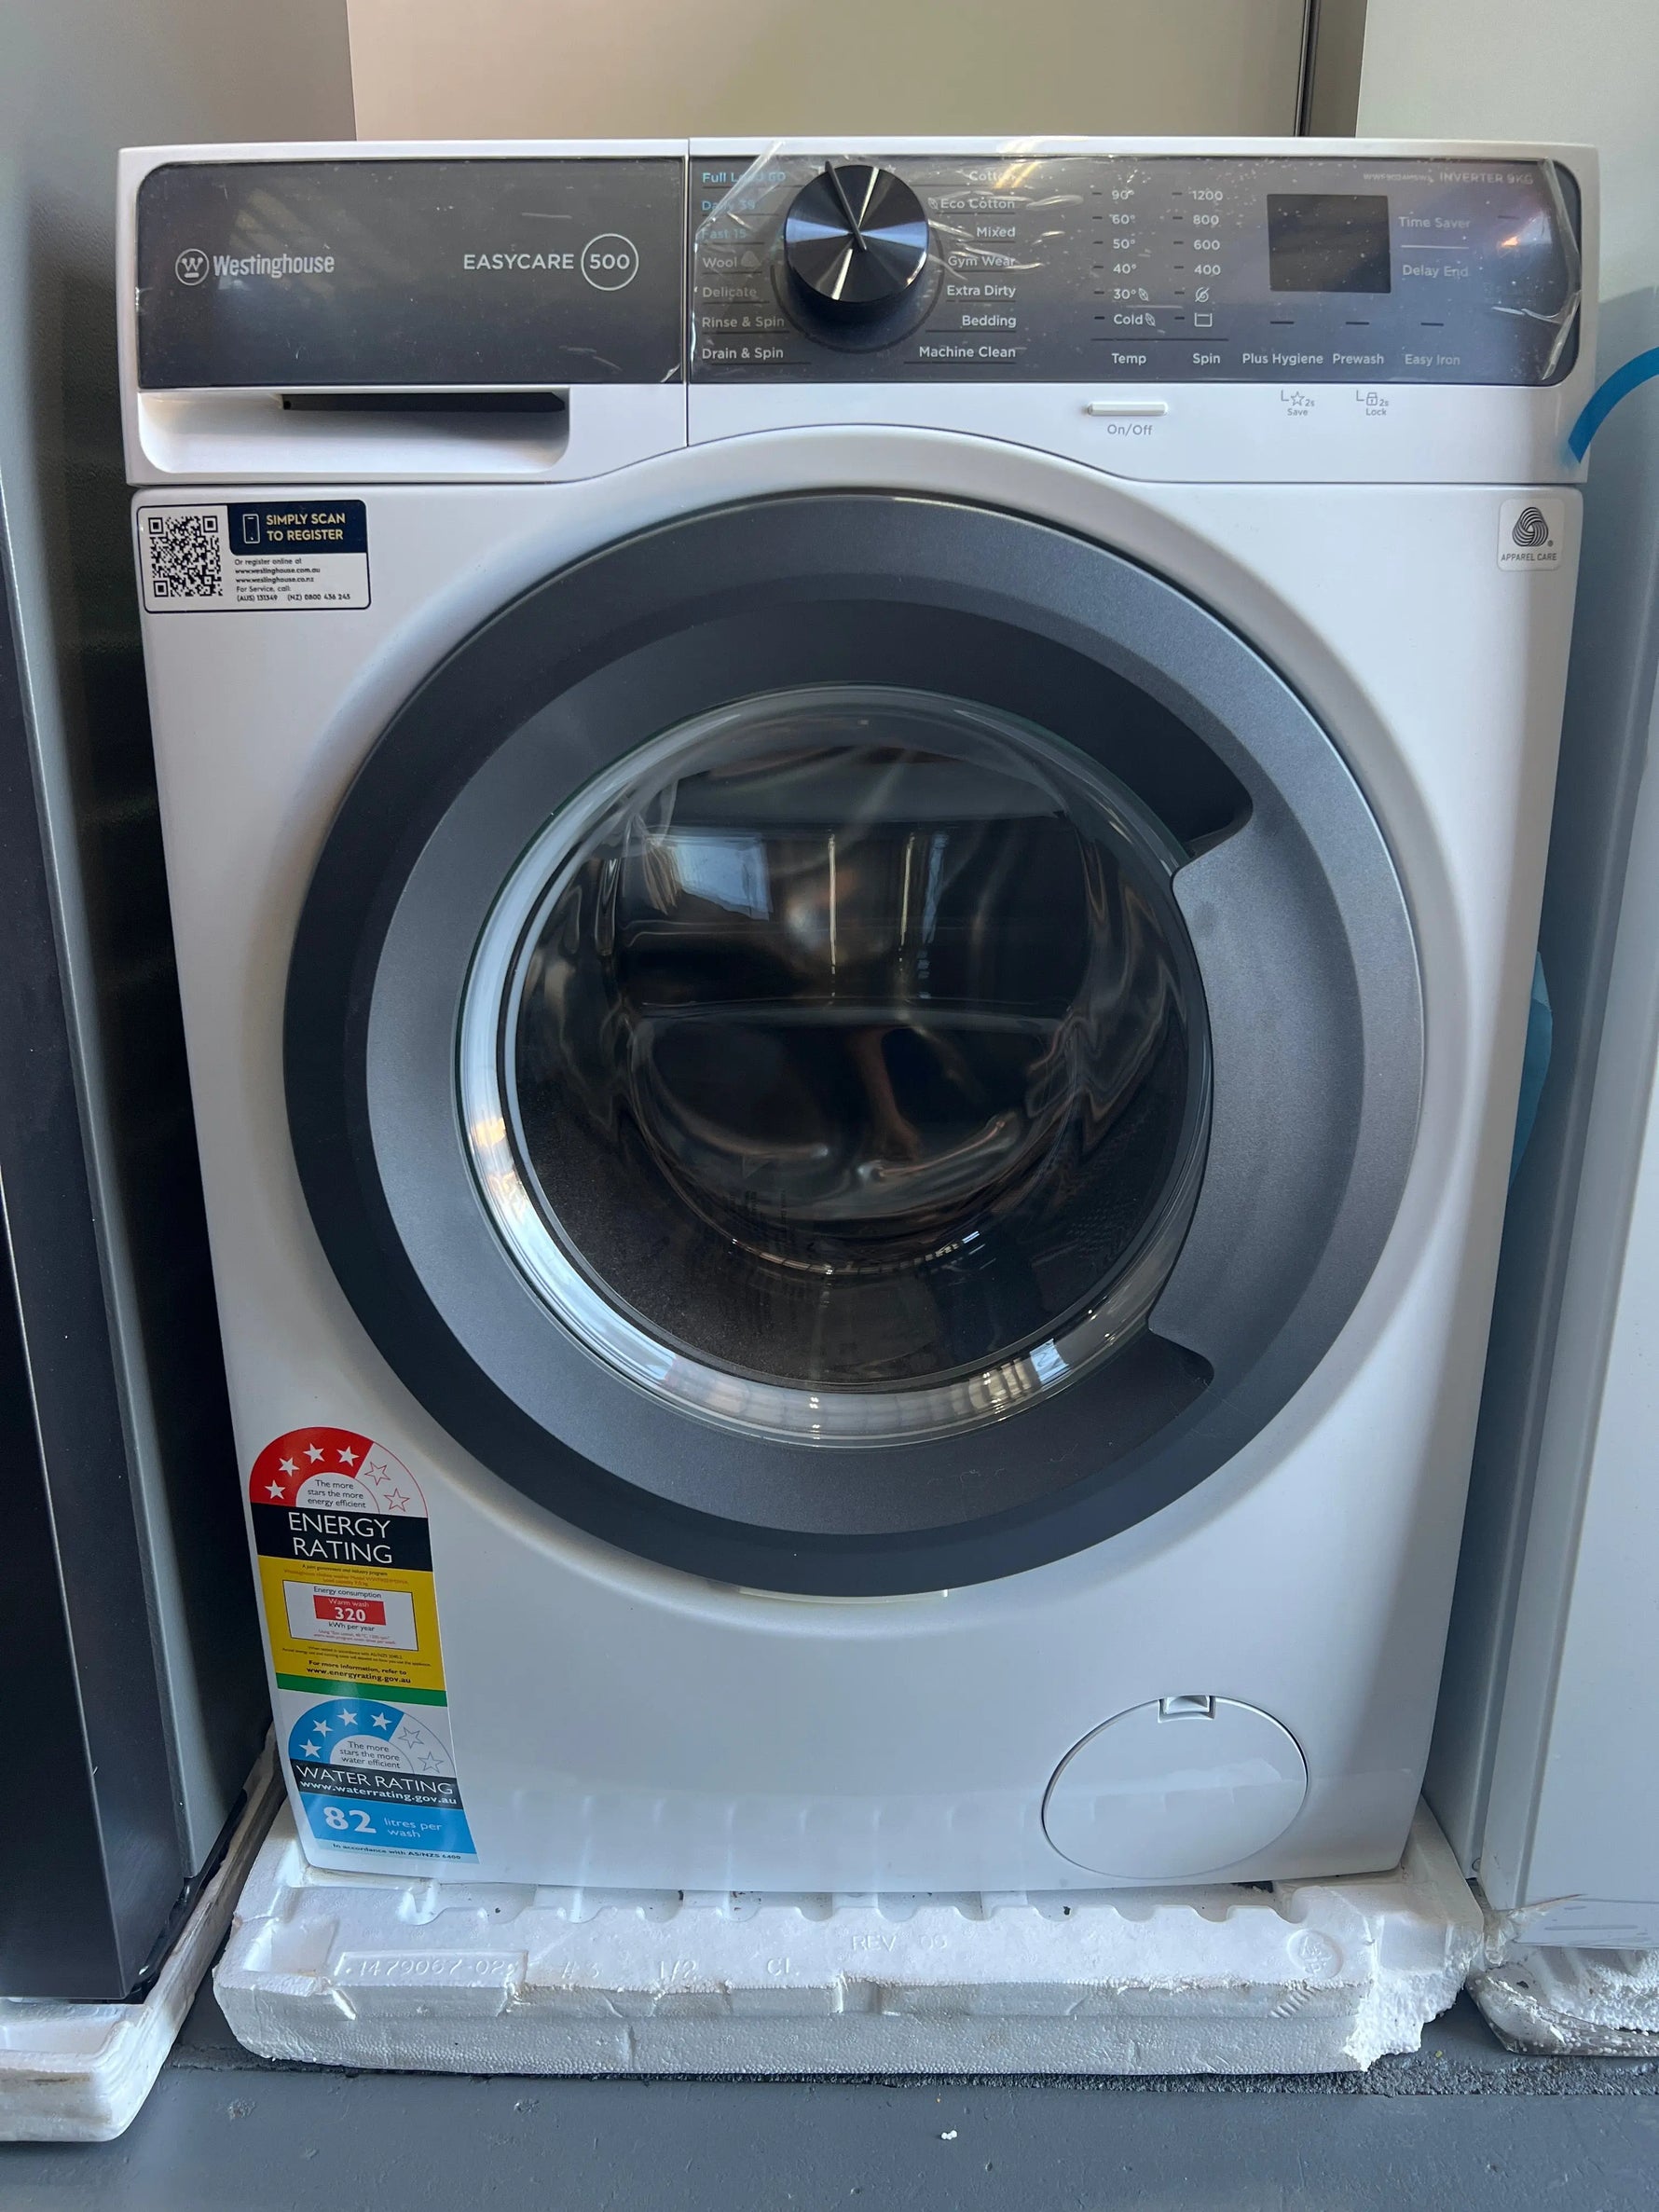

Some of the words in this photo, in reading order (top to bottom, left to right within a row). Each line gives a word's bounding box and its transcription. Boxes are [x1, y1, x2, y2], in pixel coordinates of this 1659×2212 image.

[702, 172, 726, 184] Full
[1439, 172, 1503, 184] INVERTER
[1506, 173, 1534, 185] 9KG
[1192, 190, 1223, 200] 1200
[940, 199, 966, 210] Eco
[968, 198, 1015, 210] Cotton
[1112, 214, 1136, 225] 60°
[1193, 215, 1220, 226] 800
[1398, 216, 1431, 229] Time
[1433, 217, 1471, 229] Saver
[701, 228, 730, 240] Fast
[733, 229, 747, 240] 15
[976, 227, 1016, 238] Mixed
[1113, 240, 1136, 250] 50°
[1193, 240, 1221, 251] 600
[213, 254, 335, 278] Westinghouse
[463, 254, 574, 270] EASYCARE
[589, 254, 631, 270] 500
[703, 257, 737, 269] Wool
[948, 255, 978, 268] Gym
[981, 255, 1017, 267] Wear
[1113, 264, 1137, 274] 40°
[1194, 265, 1221, 275] 400
[1402, 265, 1439, 279] Delay
[1444, 266, 1469, 278] End
[702, 286, 758, 298] Delicate
[947, 285, 980, 296] Extra
[982, 285, 1017, 299] Dirty
[1113, 289, 1137, 300] 30°
[702, 316, 741, 328] Rinse
[742, 317, 752, 328] &
[754, 316, 786, 331] Spin
[962, 314, 1017, 329] Bedding
[1114, 313, 1143, 325] Cold
[702, 348, 739, 360] Drain
[742, 348, 750, 360] &
[753, 347, 784, 363] Spin
[919, 346, 975, 359] Machine
[978, 346, 1017, 359] Clean
[1111, 353, 1147, 366] Temp
[1192, 353, 1221, 366] Spin
[1242, 353, 1269, 365] Plus
[1272, 353, 1323, 367] Hygiene
[1333, 353, 1384, 365] Prewash
[1405, 354, 1432, 367] Easy
[1435, 354, 1460, 365] Iron
[1107, 423, 1153, 436] On/Off
[266, 514, 308, 526] SIMPLY
[311, 513, 346, 525] SCAN
[267, 530, 283, 542] TO
[287, 529, 344, 542] REGISTER
[245, 558, 270, 567] register
[1501, 553, 1535, 561] APPAREL
[1537, 553, 1557, 561] CARE
[236, 576, 315, 584] www.westinghouse.co.nz
[287, 594, 303, 602] (NZ)
[314, 1478, 331, 1488] The
[308, 1498, 334, 1507] energy
[336, 1499, 366, 1508] efficient
[288, 1511, 391, 1539] ENERGY
[293, 1536, 392, 1564] RATING
[313, 1586, 336, 1595] Energy
[337, 1588, 382, 1599] consumption
[328, 1598, 351, 1606] Warm
[335, 1606, 366, 1622] 320
[328, 1621, 346, 1629] kWh
[340, 1663, 380, 1673] information,
[306, 1667, 411, 1683] www.energyrating.gov.au
[347, 1740, 364, 1750] The
[366, 1744, 390, 1752] more
[339, 1749, 360, 1757] stars
[361, 1751, 376, 1759] the
[341, 1756, 366, 1765] water
[367, 1758, 401, 1769] efficient
[295, 1765, 371, 1787] WATER
[375, 1775, 454, 1795] RATING
[299, 1779, 458, 1805] www.waterrating.gov.au
[322, 1806, 377, 1834] 82
[383, 1817, 417, 1829] litres
[420, 1822, 443, 1832] per
[387, 1828, 420, 1839] wash
[342, 1845, 387, 1854] accordance
[851, 1934, 897, 1952] REV
